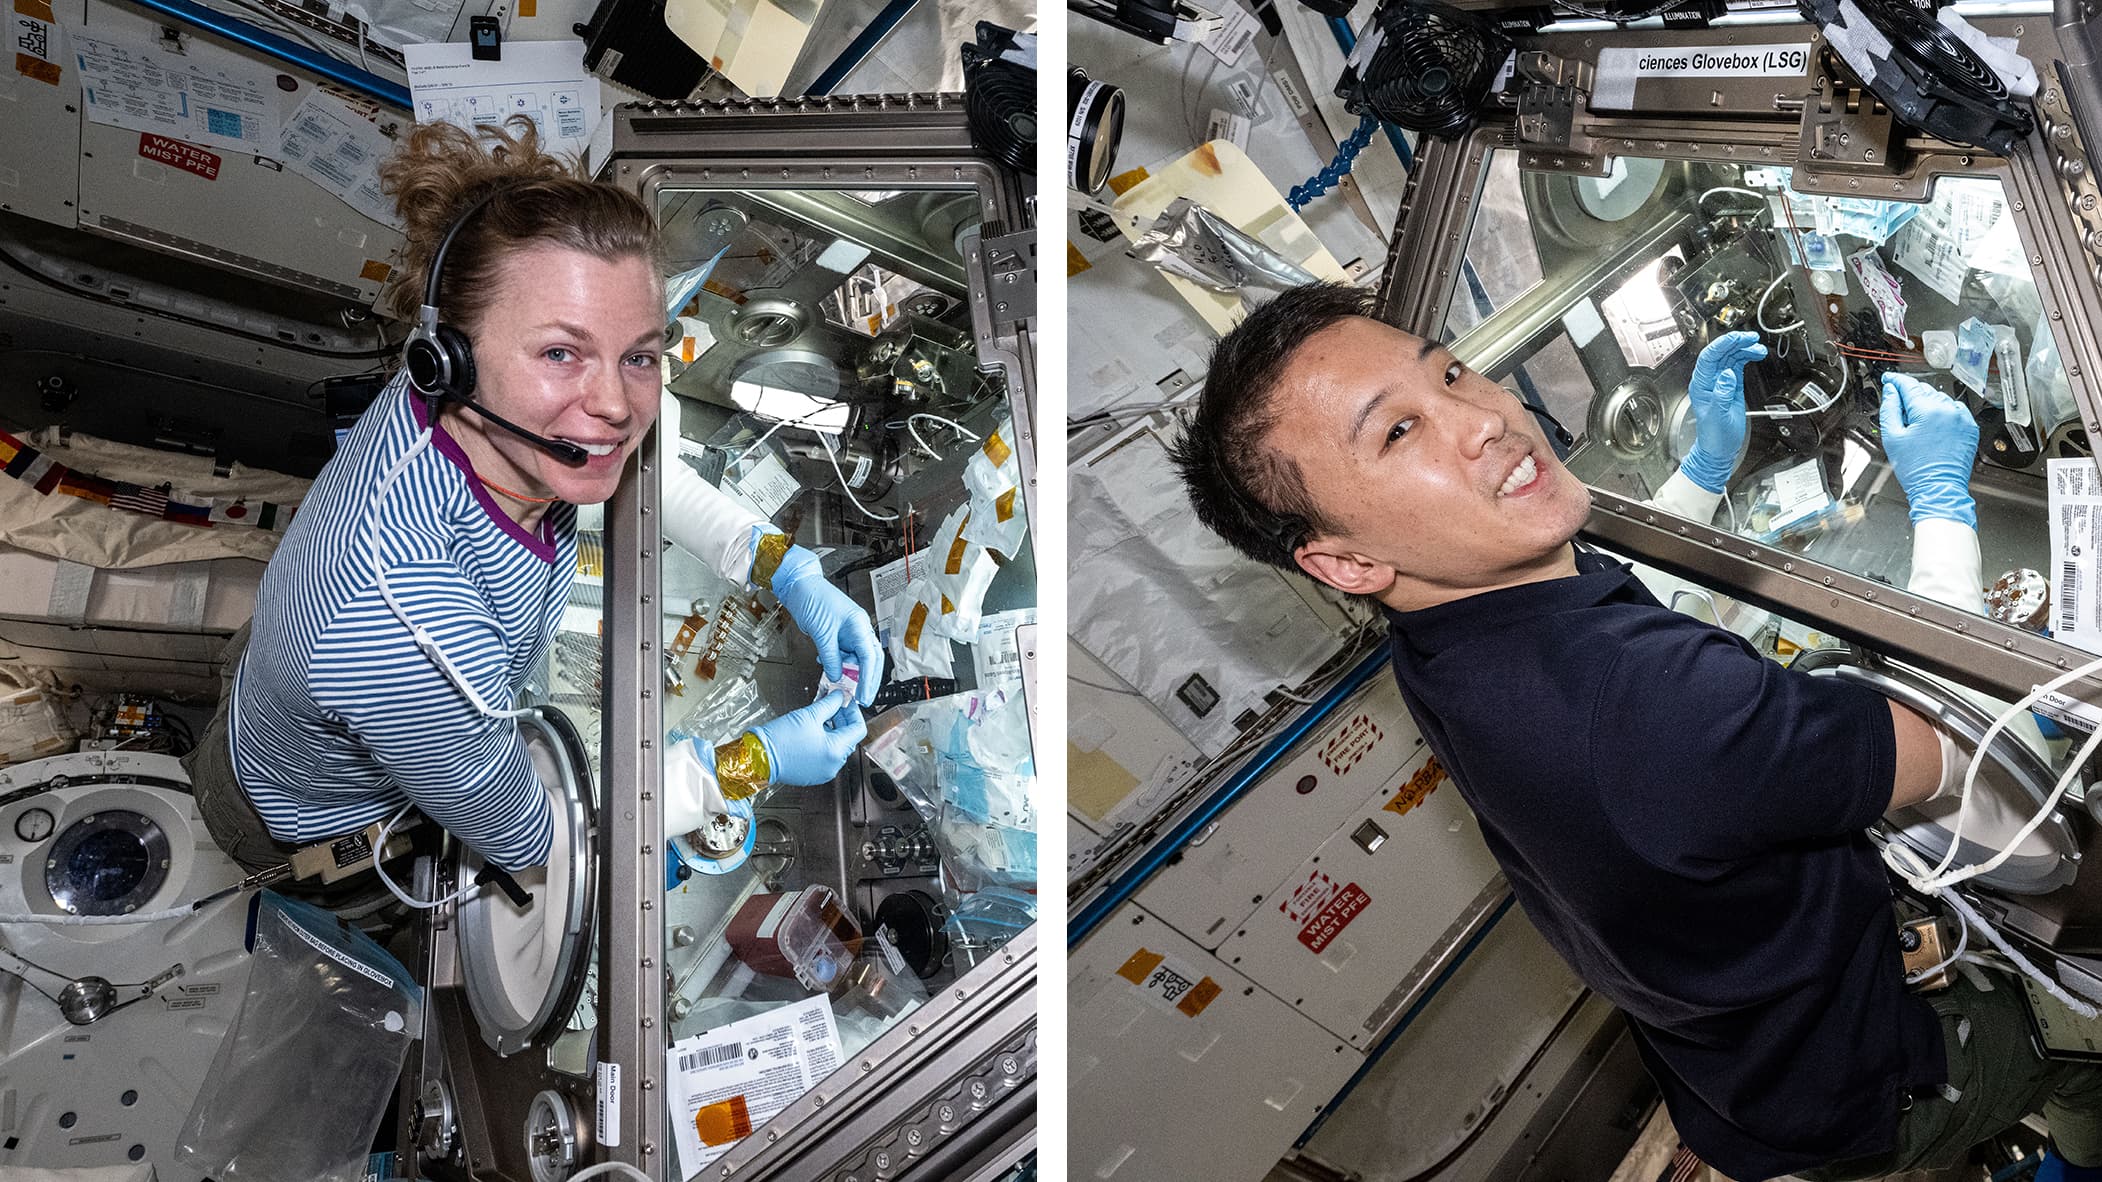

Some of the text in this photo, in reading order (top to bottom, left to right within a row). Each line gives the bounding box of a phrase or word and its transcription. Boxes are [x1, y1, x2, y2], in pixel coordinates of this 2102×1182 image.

[1501, 20, 1531, 29] ILLUMINATION
[1664, 11, 1702, 22] ILLUMINATION
[1639, 50, 1807, 73] ciences Glovebox (LSG)
[143, 145, 217, 177] MIST PFE
[152, 137, 212, 164] WATER
[2049, 695, 2066, 706] Door
[1350, 728, 1369, 747] PORT
[1300, 887, 1321, 908] FIRE
[1307, 891, 1354, 935] WATER
[1310, 892, 1368, 949] MIST PFE
[335, 952, 357, 969] PLACING
[363, 966, 393, 986] GLOVEBOX
